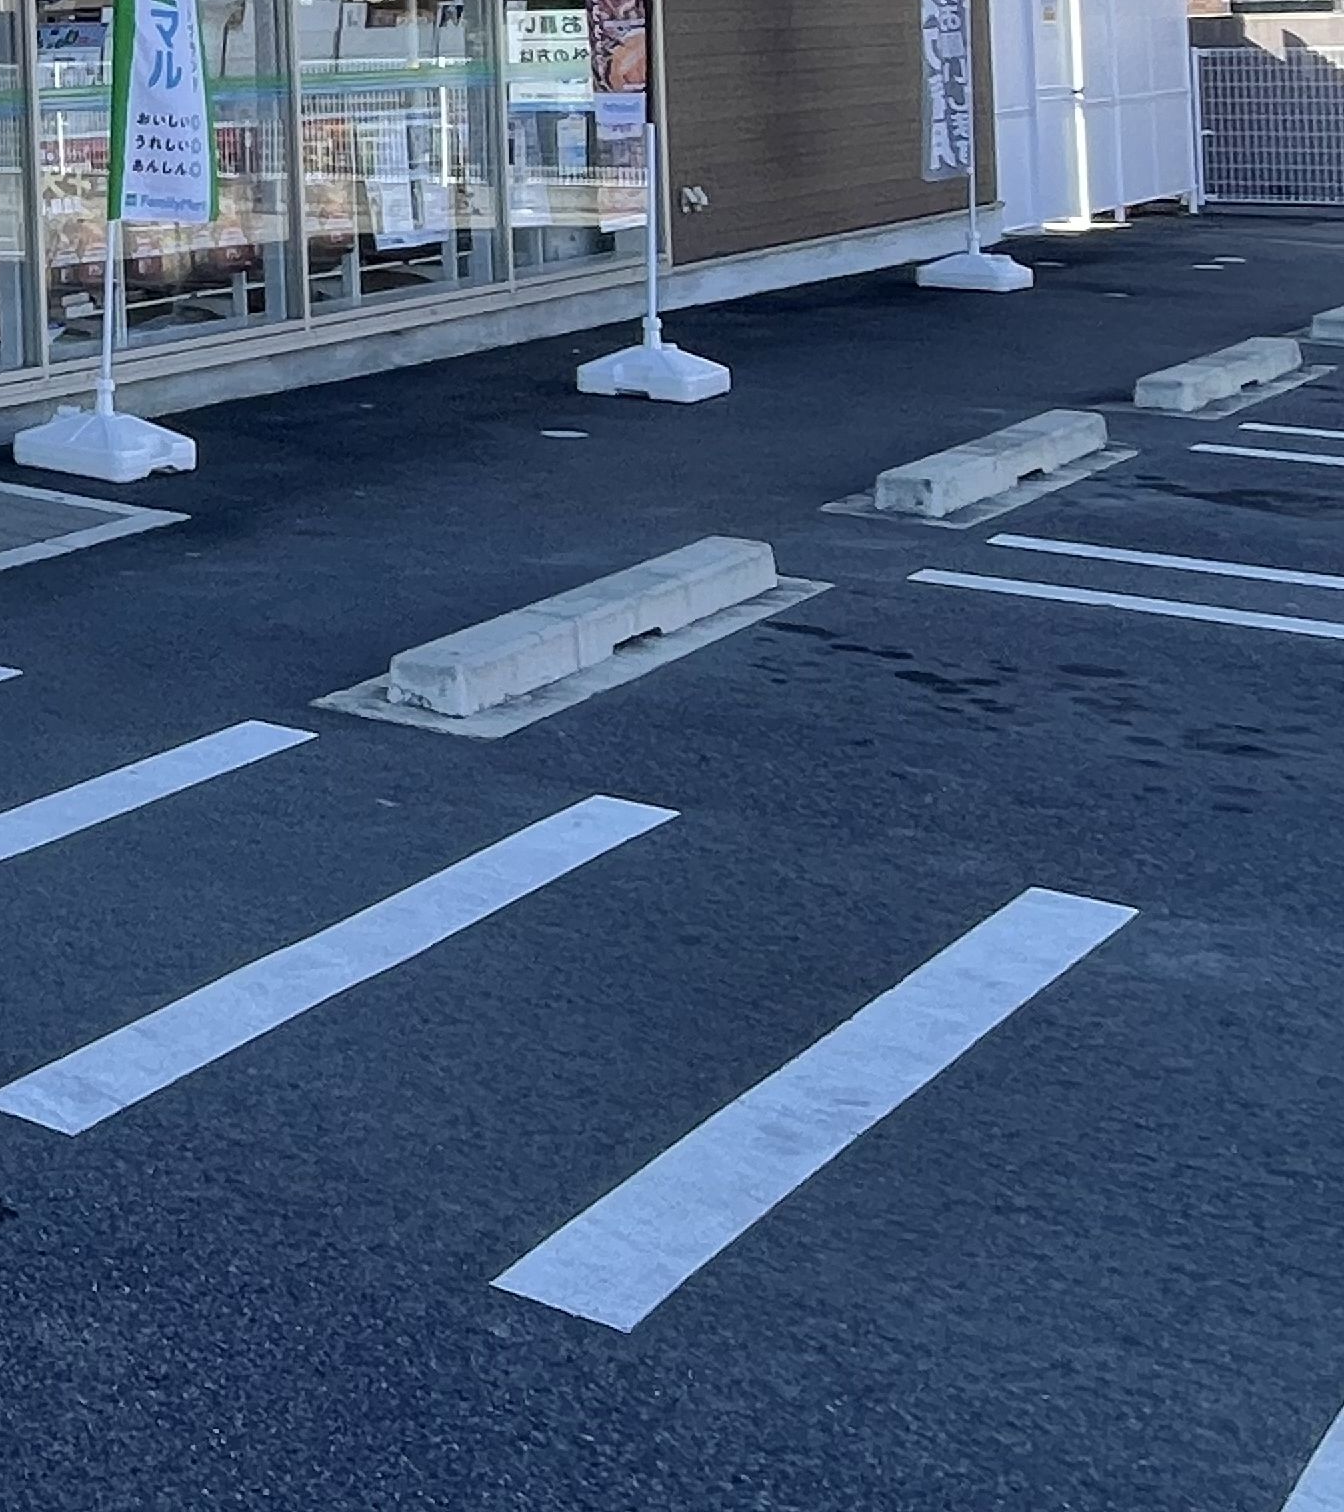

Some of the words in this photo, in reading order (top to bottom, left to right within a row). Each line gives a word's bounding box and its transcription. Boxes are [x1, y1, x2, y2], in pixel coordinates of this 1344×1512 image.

[136, 112, 190, 128] おいしい
[135, 134, 189, 151] うれしい
[132, 159, 187, 175] あんしん
